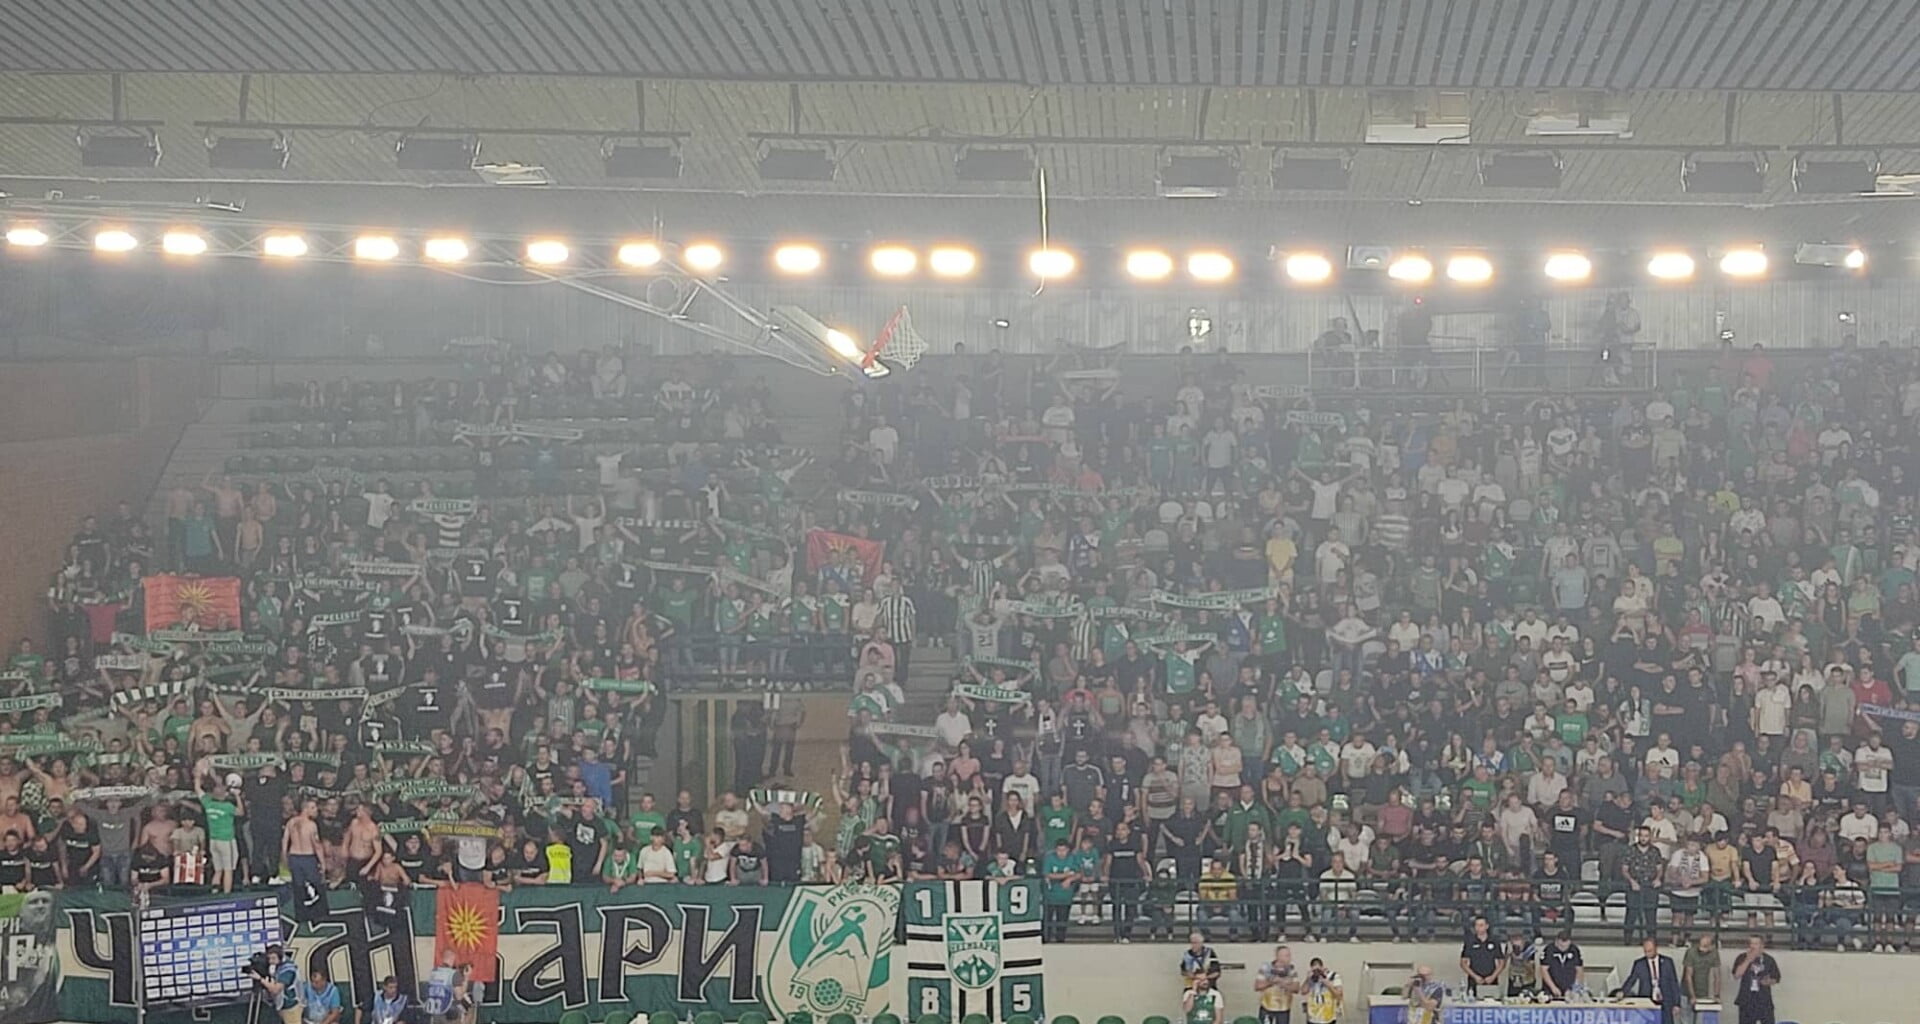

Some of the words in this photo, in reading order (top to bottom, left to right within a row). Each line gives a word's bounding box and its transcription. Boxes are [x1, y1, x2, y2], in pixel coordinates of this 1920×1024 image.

[916, 889, 932, 918] 1
[1010, 886, 1029, 914] 9
[788, 984, 806, 999] 19
[844, 999, 865, 1016] 55
[921, 987, 939, 1015] 8
[1013, 984, 1031, 1012] 5
